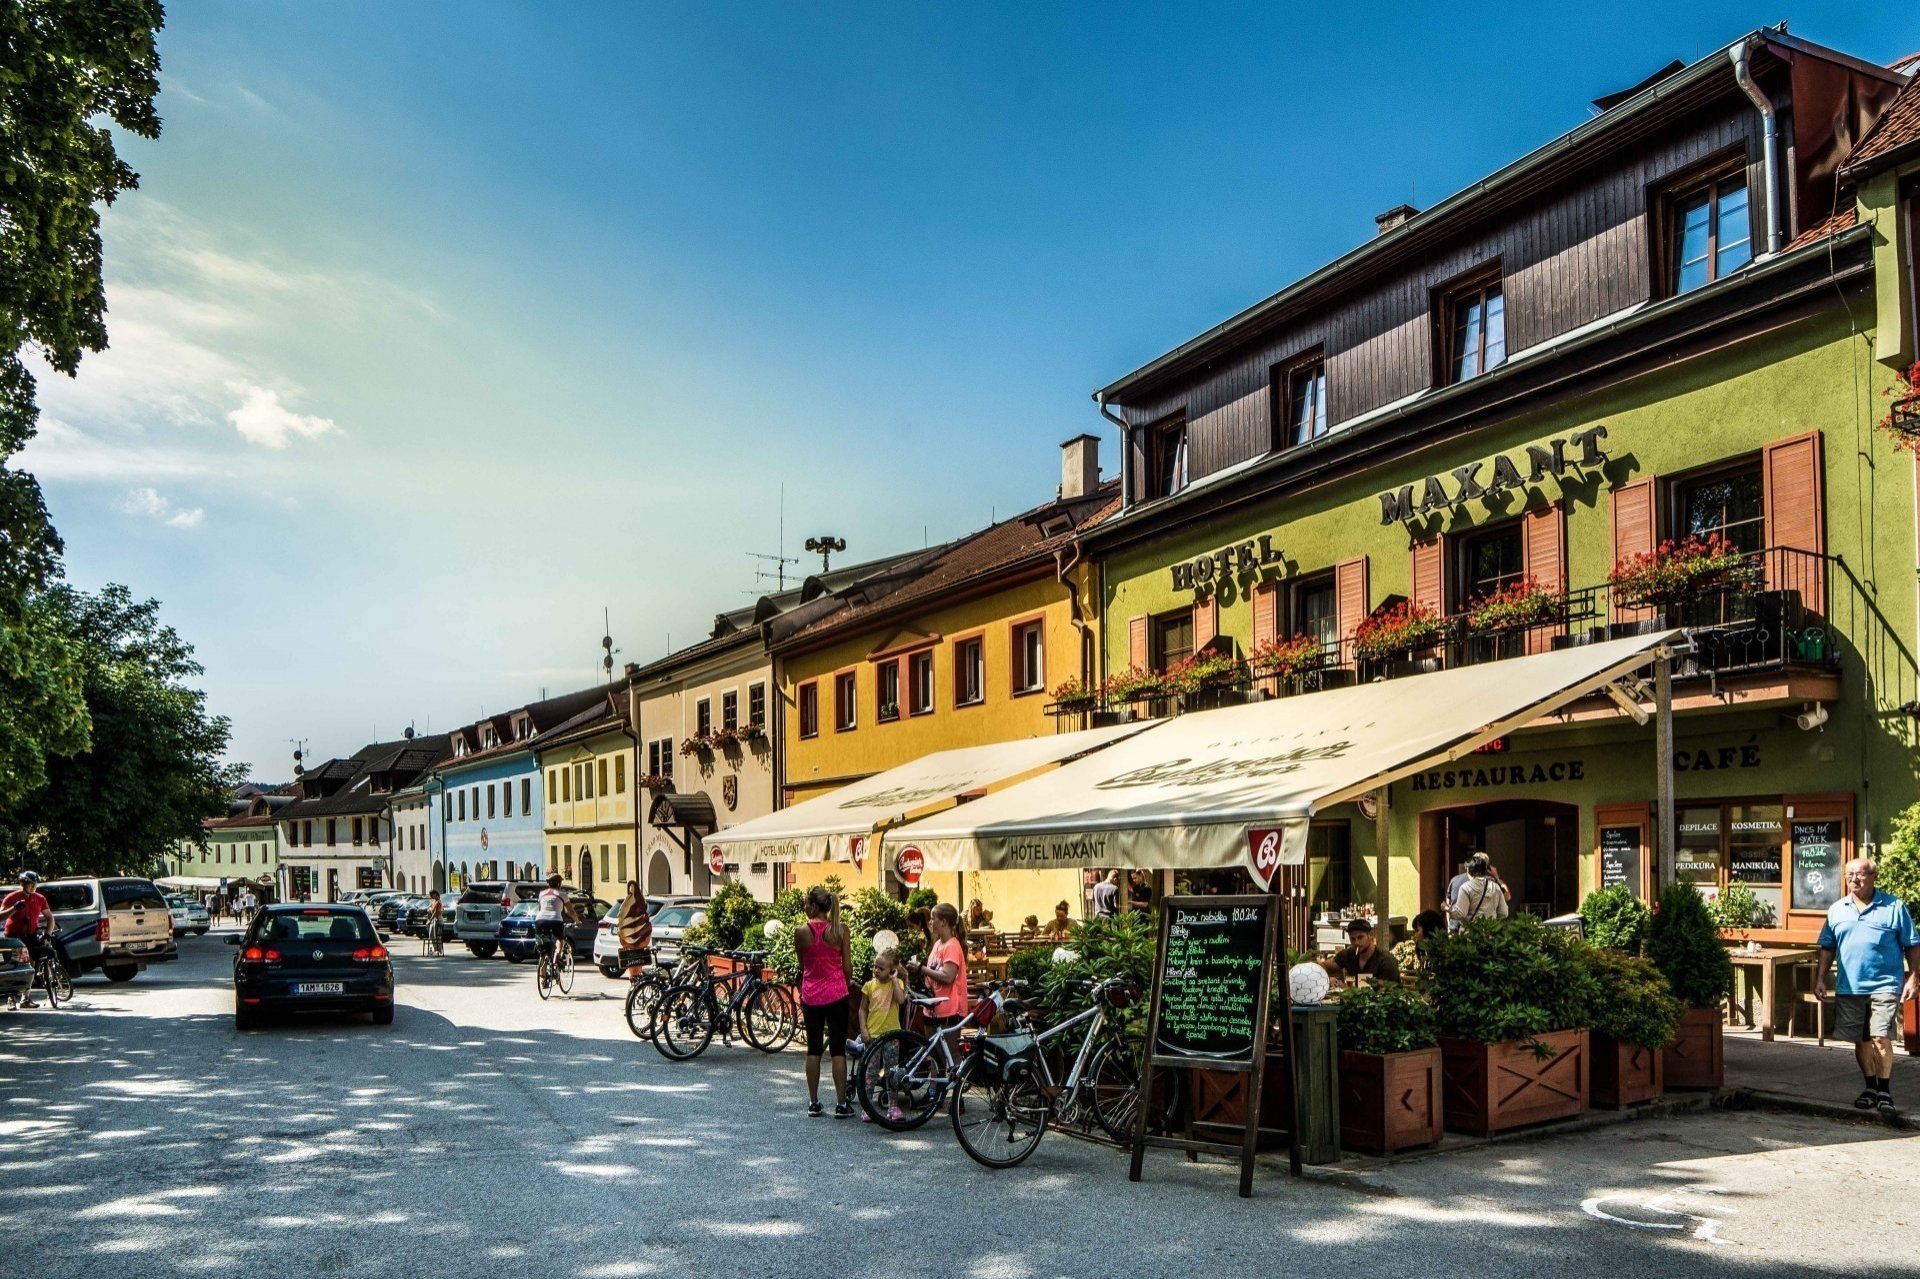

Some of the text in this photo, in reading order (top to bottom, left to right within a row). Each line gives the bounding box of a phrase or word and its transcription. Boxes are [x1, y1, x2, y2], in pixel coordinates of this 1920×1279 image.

[1171, 425, 1611, 591] HOTEL MAXANT
[1673, 735, 1761, 772] CAFÉ
[1411, 761, 1585, 791] RESTAURACE
[1679, 823, 1718, 831] DEPILACE
[1731, 821, 1782, 830] KOSMETIKA
[1794, 825, 1815, 835] DNES
[760, 845, 777, 856] HOTEL
[1010, 841, 1106, 860] HOTEL MAXANT
[1675, 861, 1716, 870] PEDIKÚRA
[1732, 861, 1780, 870] MANIKÚRA
[1798, 860, 1826, 868] Helena
[300, 983, 340, 992] 1AM 1626
